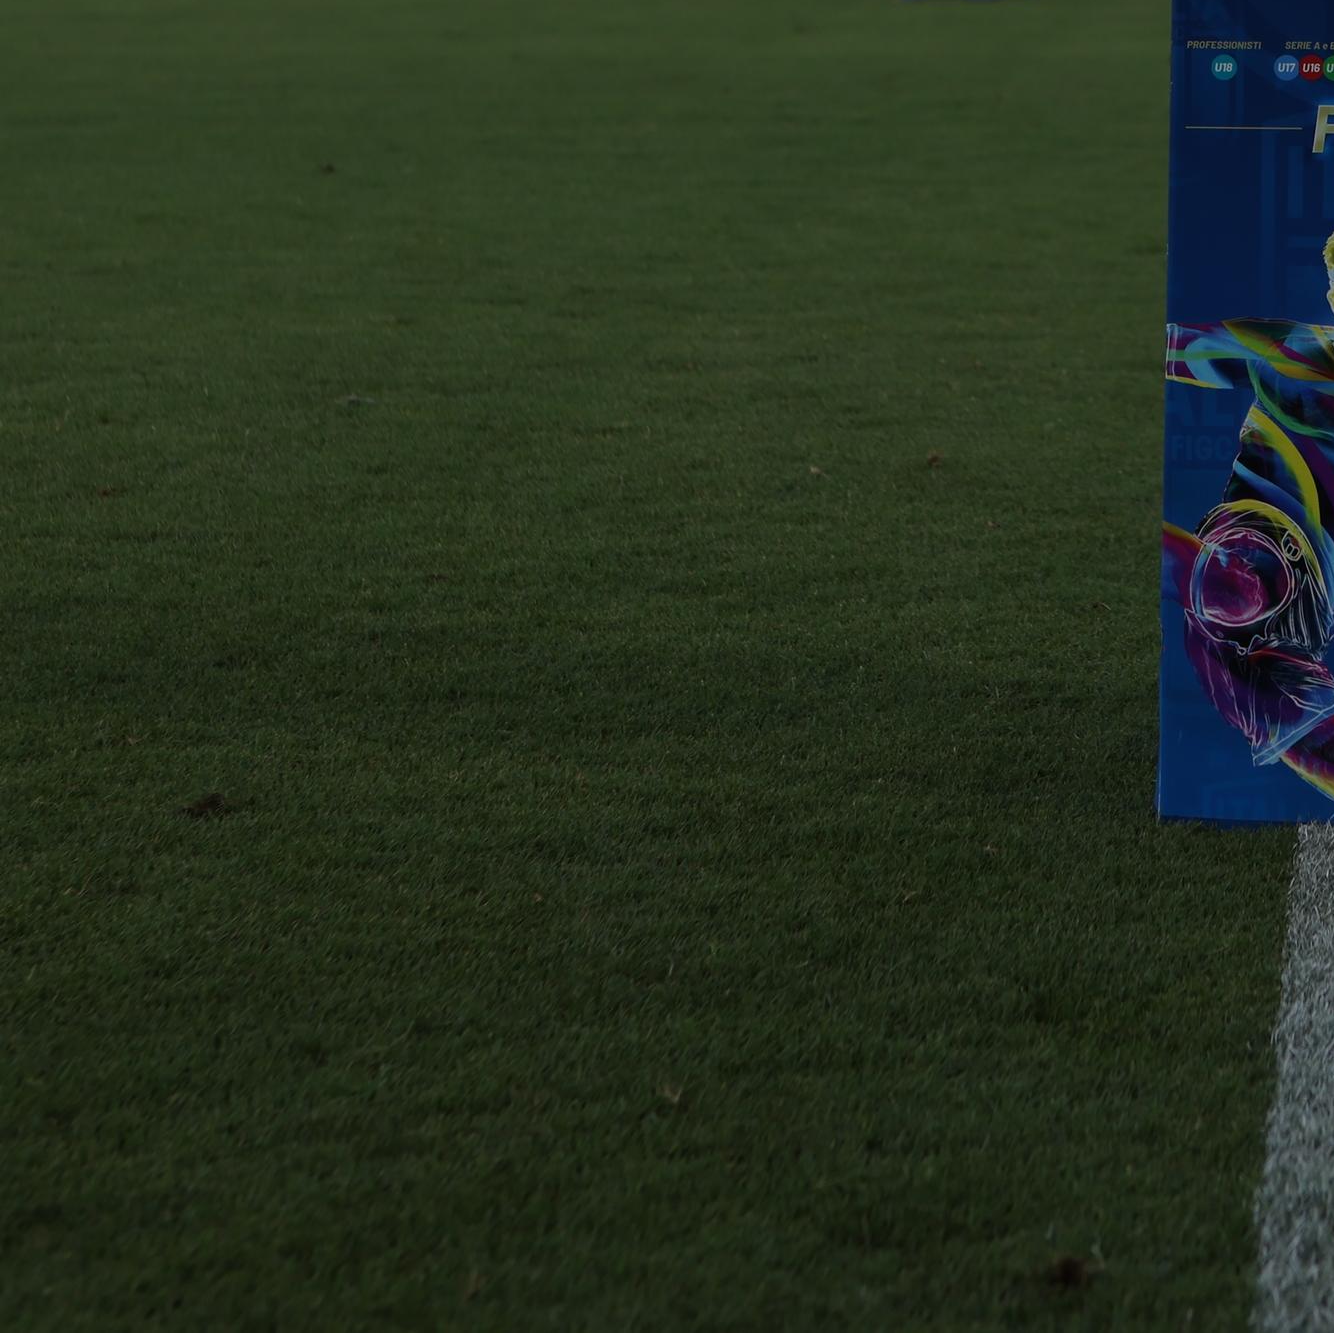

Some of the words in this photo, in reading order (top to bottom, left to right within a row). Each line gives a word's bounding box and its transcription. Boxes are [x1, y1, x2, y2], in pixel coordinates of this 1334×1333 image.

[1186, 40, 1262, 50] PROFESSIONISTI
[1285, 41, 1312, 50] SERIE
[1313, 41, 1321, 50] A
[1214, 62, 1233, 73] U18
[1278, 63, 1296, 73] U17
[1302, 63, 1321, 73] U16
